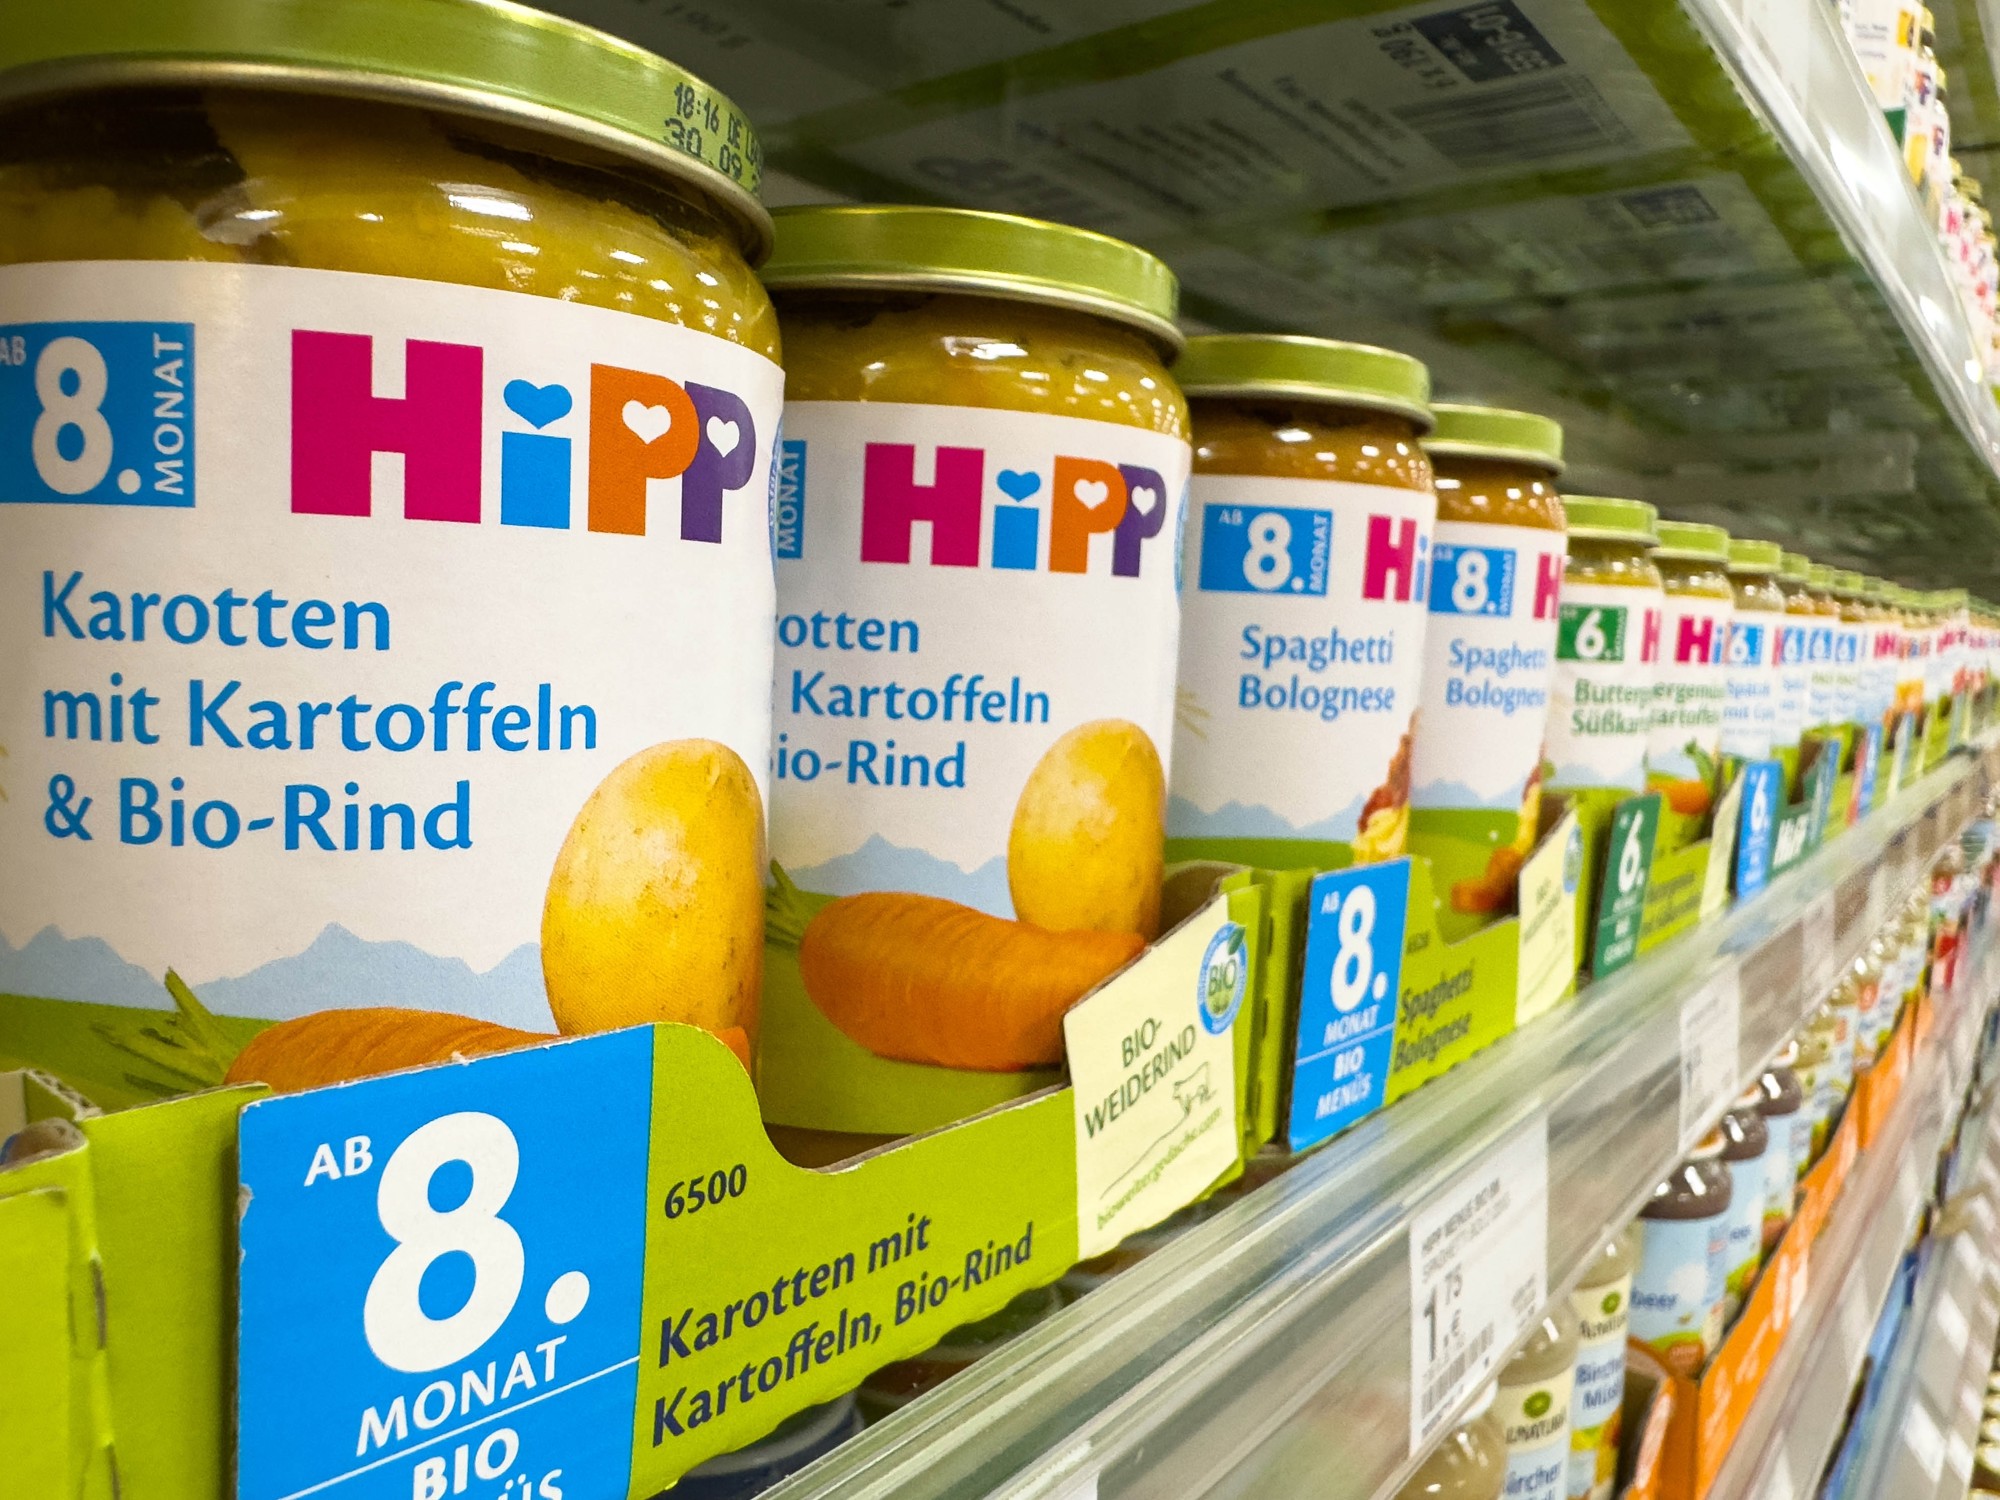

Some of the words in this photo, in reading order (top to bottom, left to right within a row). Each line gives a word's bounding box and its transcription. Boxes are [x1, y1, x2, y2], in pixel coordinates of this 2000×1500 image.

[674, 82, 720, 136] 18:16
[31, 335, 142, 496] 8.
[153, 332, 185, 496] MONAT
[291, 329, 757, 544] HiPP
[777, 449, 801, 553] MONAT
[859, 442, 1167, 578] HiPP
[1242, 511, 1305, 592] 8.
[1451, 551, 1498, 613] 8.
[41, 570, 392, 652] Karotten
[774, 612, 920, 654] otten
[1240, 623, 1396, 674] Spaghetti
[43, 672, 160, 745] mit
[188, 679, 599, 753] Kartoffeln
[791, 669, 1050, 725] Kartoffeln
[1237, 674, 1397, 722] Bolognese
[769, 733, 967, 789] io-Rind
[44, 773, 93, 842] &
[118, 777, 473, 852] Bio-Rind
[1207, 958, 1238, 997] BIO
[1330, 884, 1389, 1013] 8.
[1121, 1016, 1162, 1069] BIO-
[1322, 1003, 1381, 1047] MONAT
[1333, 1045, 1366, 1082] BIO
[1084, 1023, 1198, 1139] WEIDERIND
[663, 1163, 749, 1220] 6500
[303, 1135, 374, 1187] AB
[363, 1110, 591, 1375] 8.
[657, 1252, 856, 1369] Karotten
[868, 1211, 932, 1273] mit
[651, 1308, 884, 1448] Kartoffeln,
[894, 1221, 1034, 1328] Bio-Rind
[355, 1336, 568, 1458] MONAT
[412, 1427, 520, 1500] BIO
